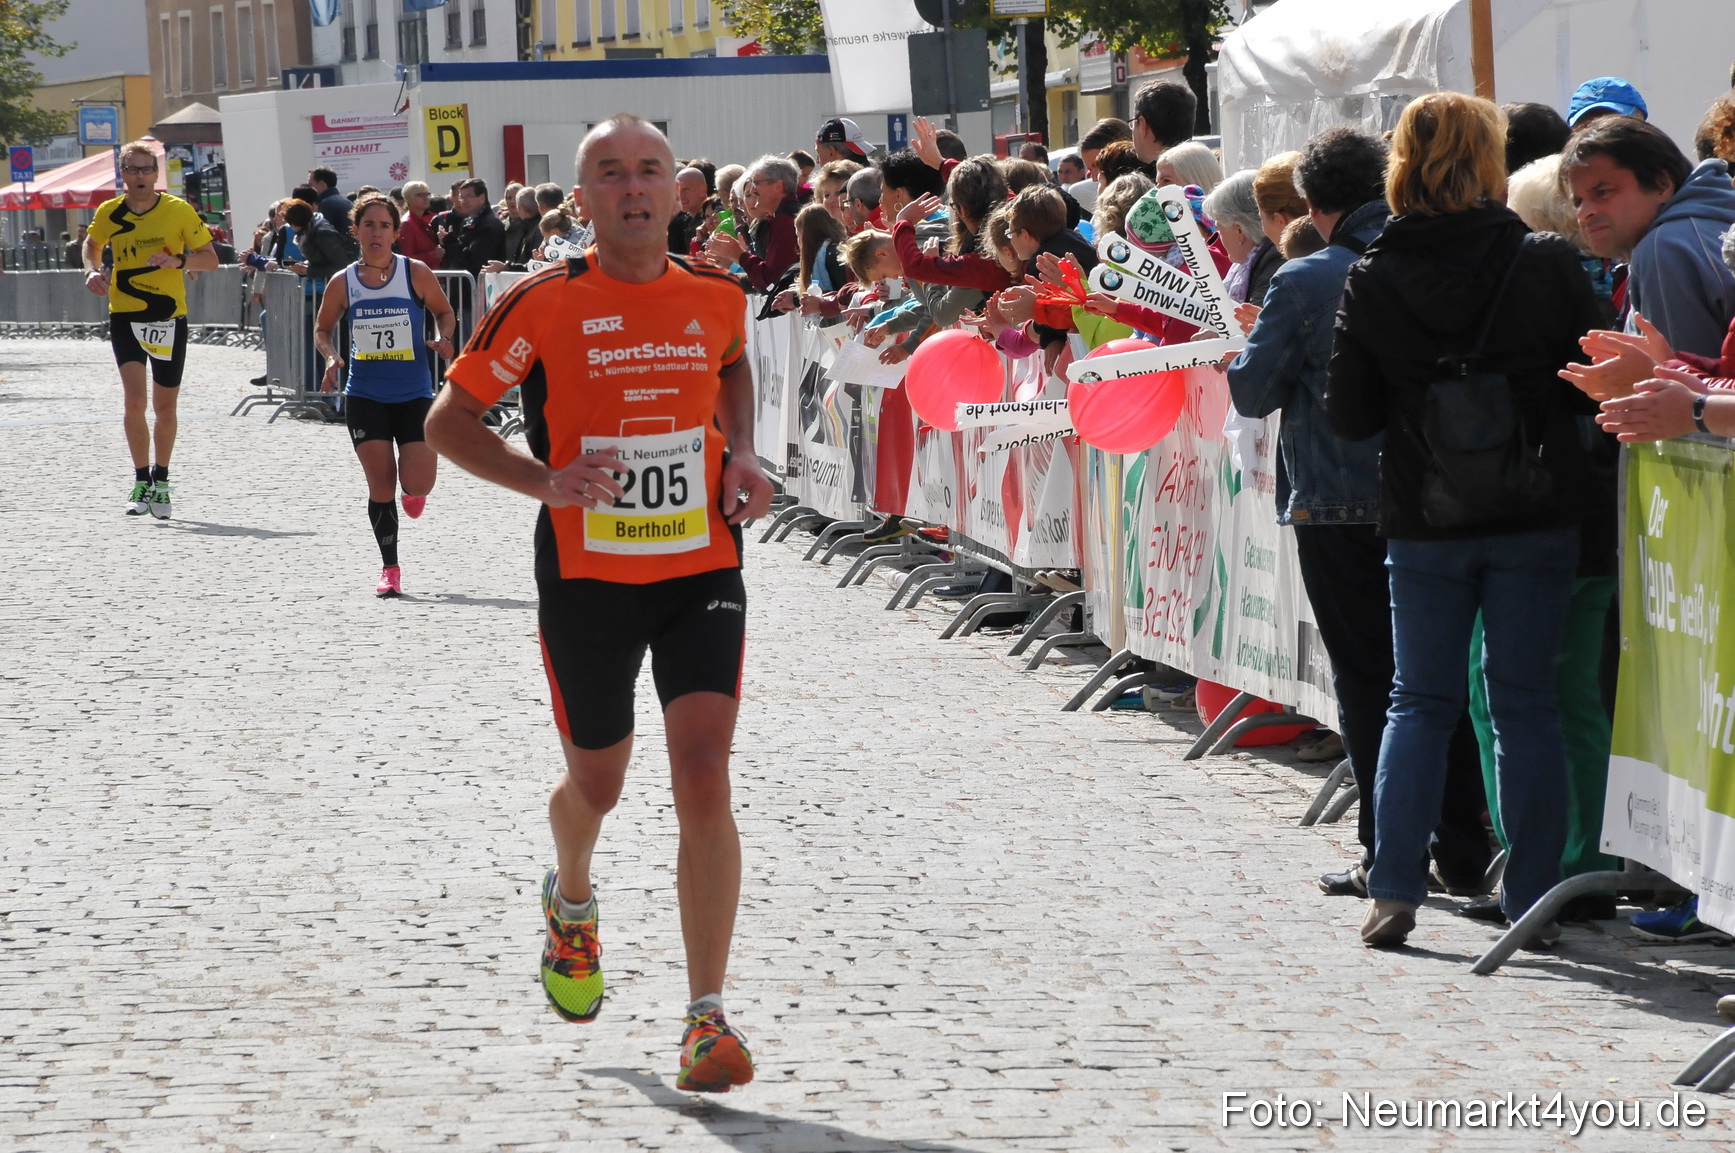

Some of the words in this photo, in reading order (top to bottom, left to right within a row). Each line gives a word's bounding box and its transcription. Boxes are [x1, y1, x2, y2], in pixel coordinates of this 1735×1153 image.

[330, 116, 361, 125] DAHMIT
[429, 107, 464, 121] Block
[334, 143, 382, 155] DAHMIT
[437, 125, 461, 158] D
[13, 171, 33, 181] TAXI
[1137, 258, 1190, 294] BMW
[363, 308, 383, 316] TELIS
[384, 307, 409, 315] FINANZ
[373, 322, 402, 330] Neumarkt
[582, 315, 624, 335] DAK
[140, 327, 167, 344] 107
[371, 330, 395, 350] 73
[508, 336, 533, 363] BR
[587, 341, 707, 366] SportScheck
[589, 370, 603, 379] 14.
[605, 363, 651, 376] Nürnberger
[653, 362, 690, 372] Stadtlauf
[691, 362, 708, 372] 2009
[586, 448, 630, 461] PTL
[633, 444, 689, 460] Neumarkt
[612, 461, 689, 510] 205
[1648, 485, 1669, 538] Der
[615, 518, 686, 538] Berthold
[720, 601, 742, 612] asics
